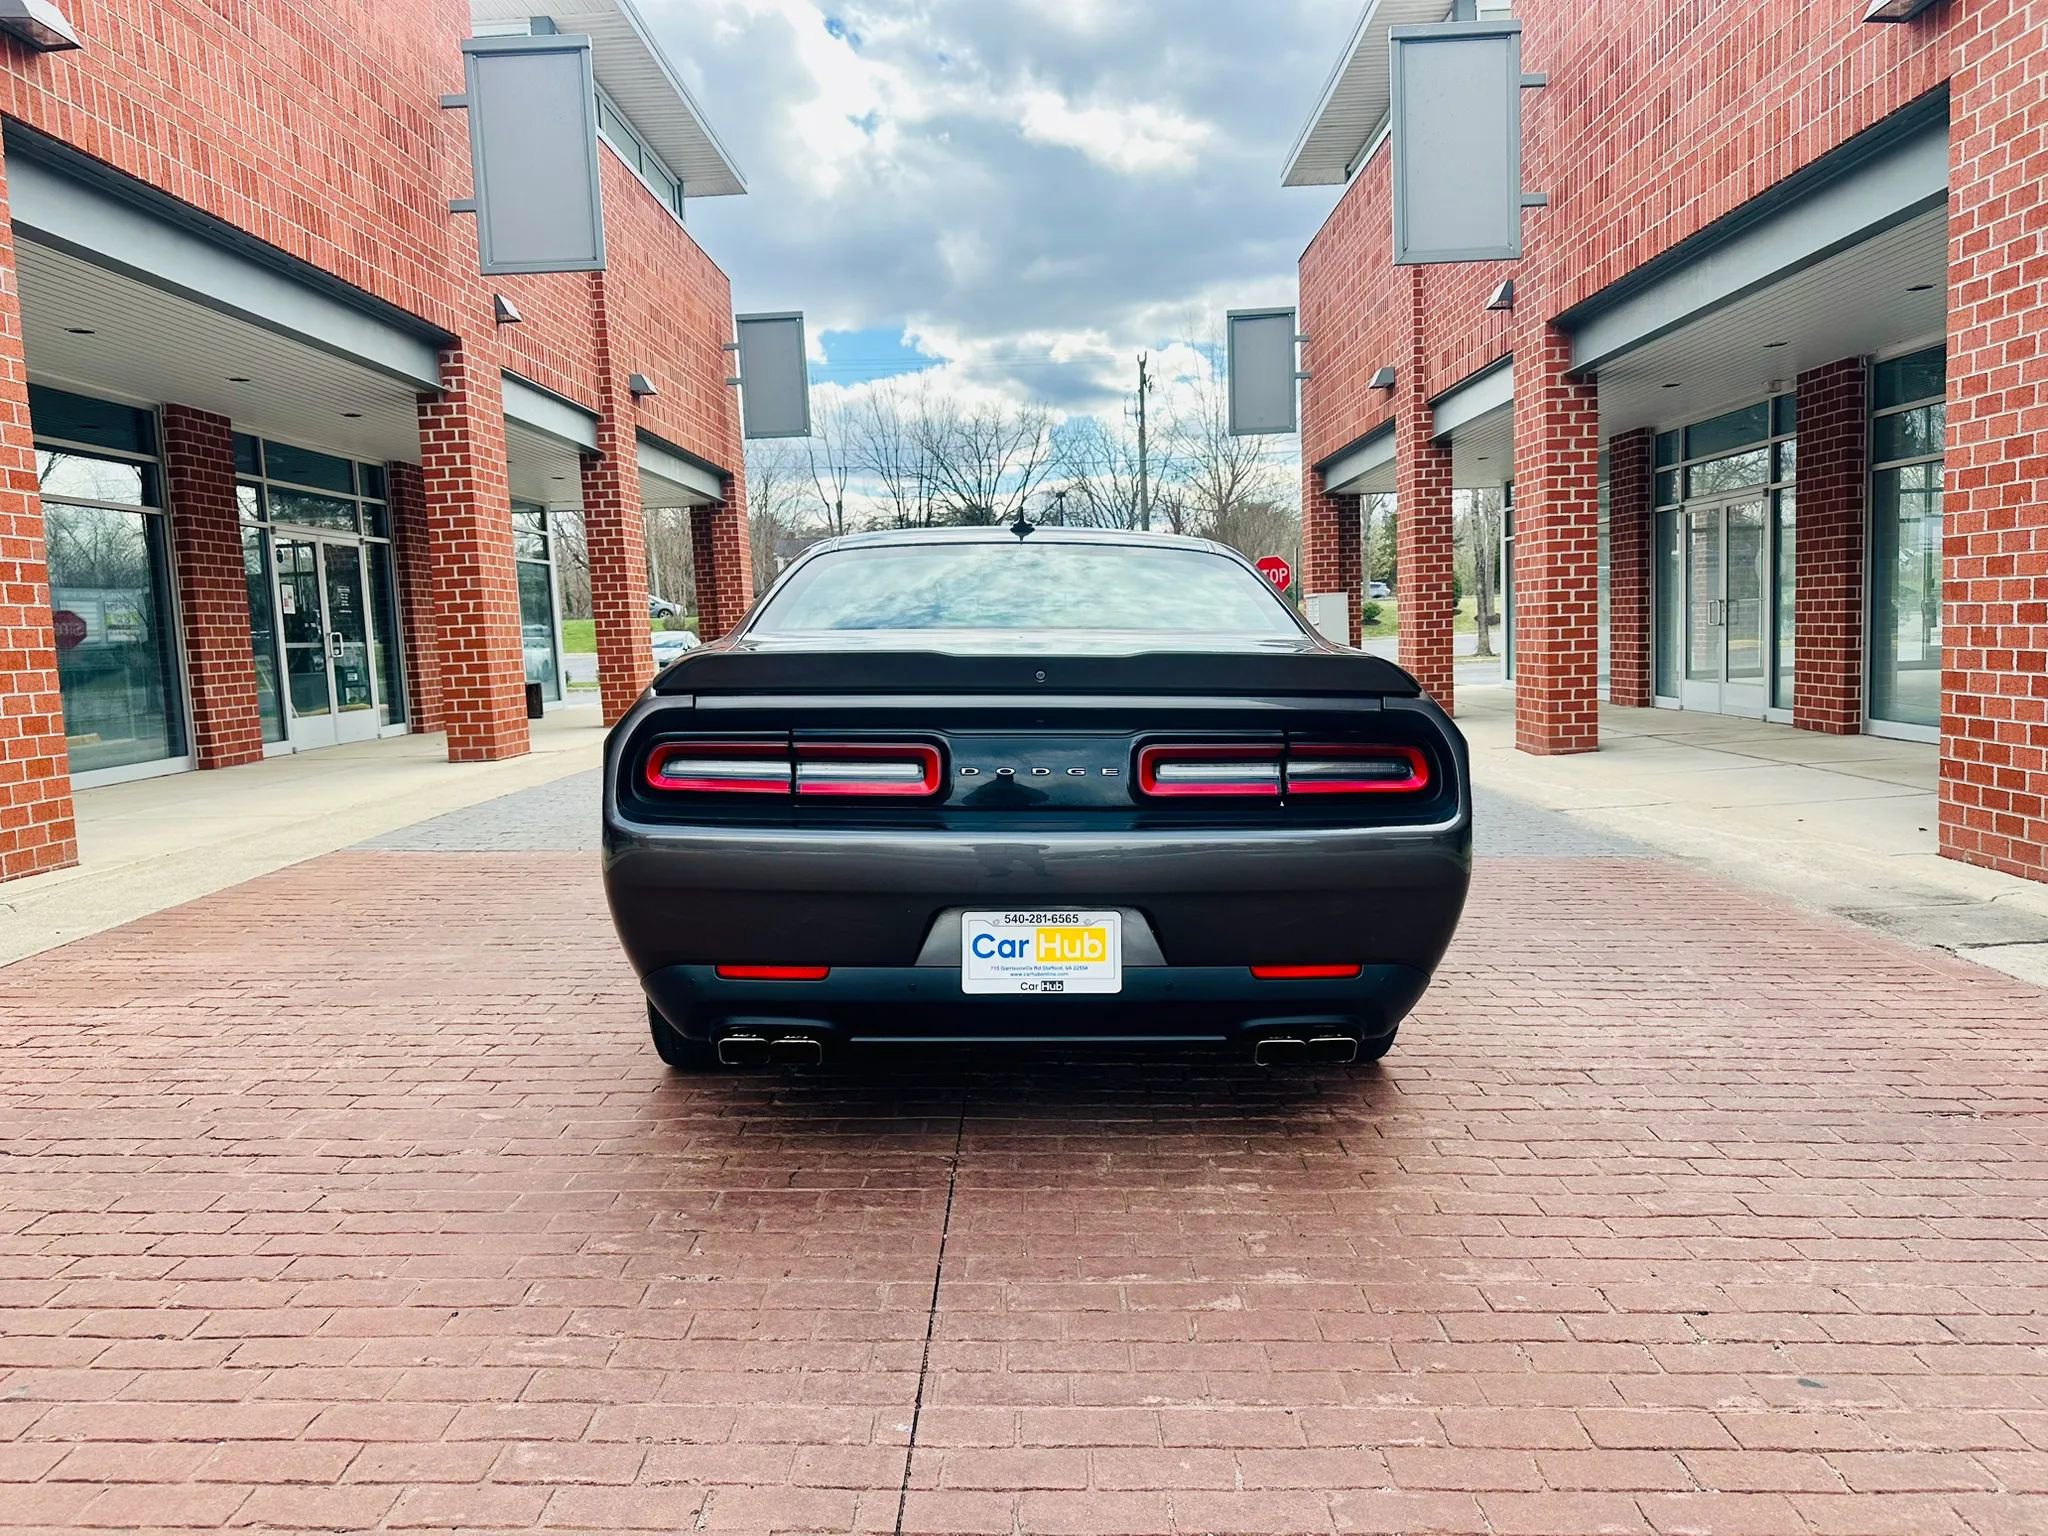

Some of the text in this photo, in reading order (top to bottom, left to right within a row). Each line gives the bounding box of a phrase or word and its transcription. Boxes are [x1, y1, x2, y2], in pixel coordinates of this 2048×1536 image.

[1261, 567, 1288, 584] TOP
[960, 766, 1121, 777] DODGE
[1004, 913, 1079, 924] 540-281-6565
[972, 931, 1103, 959] Car Hub
[1020, 981, 1063, 991] Car Hub
